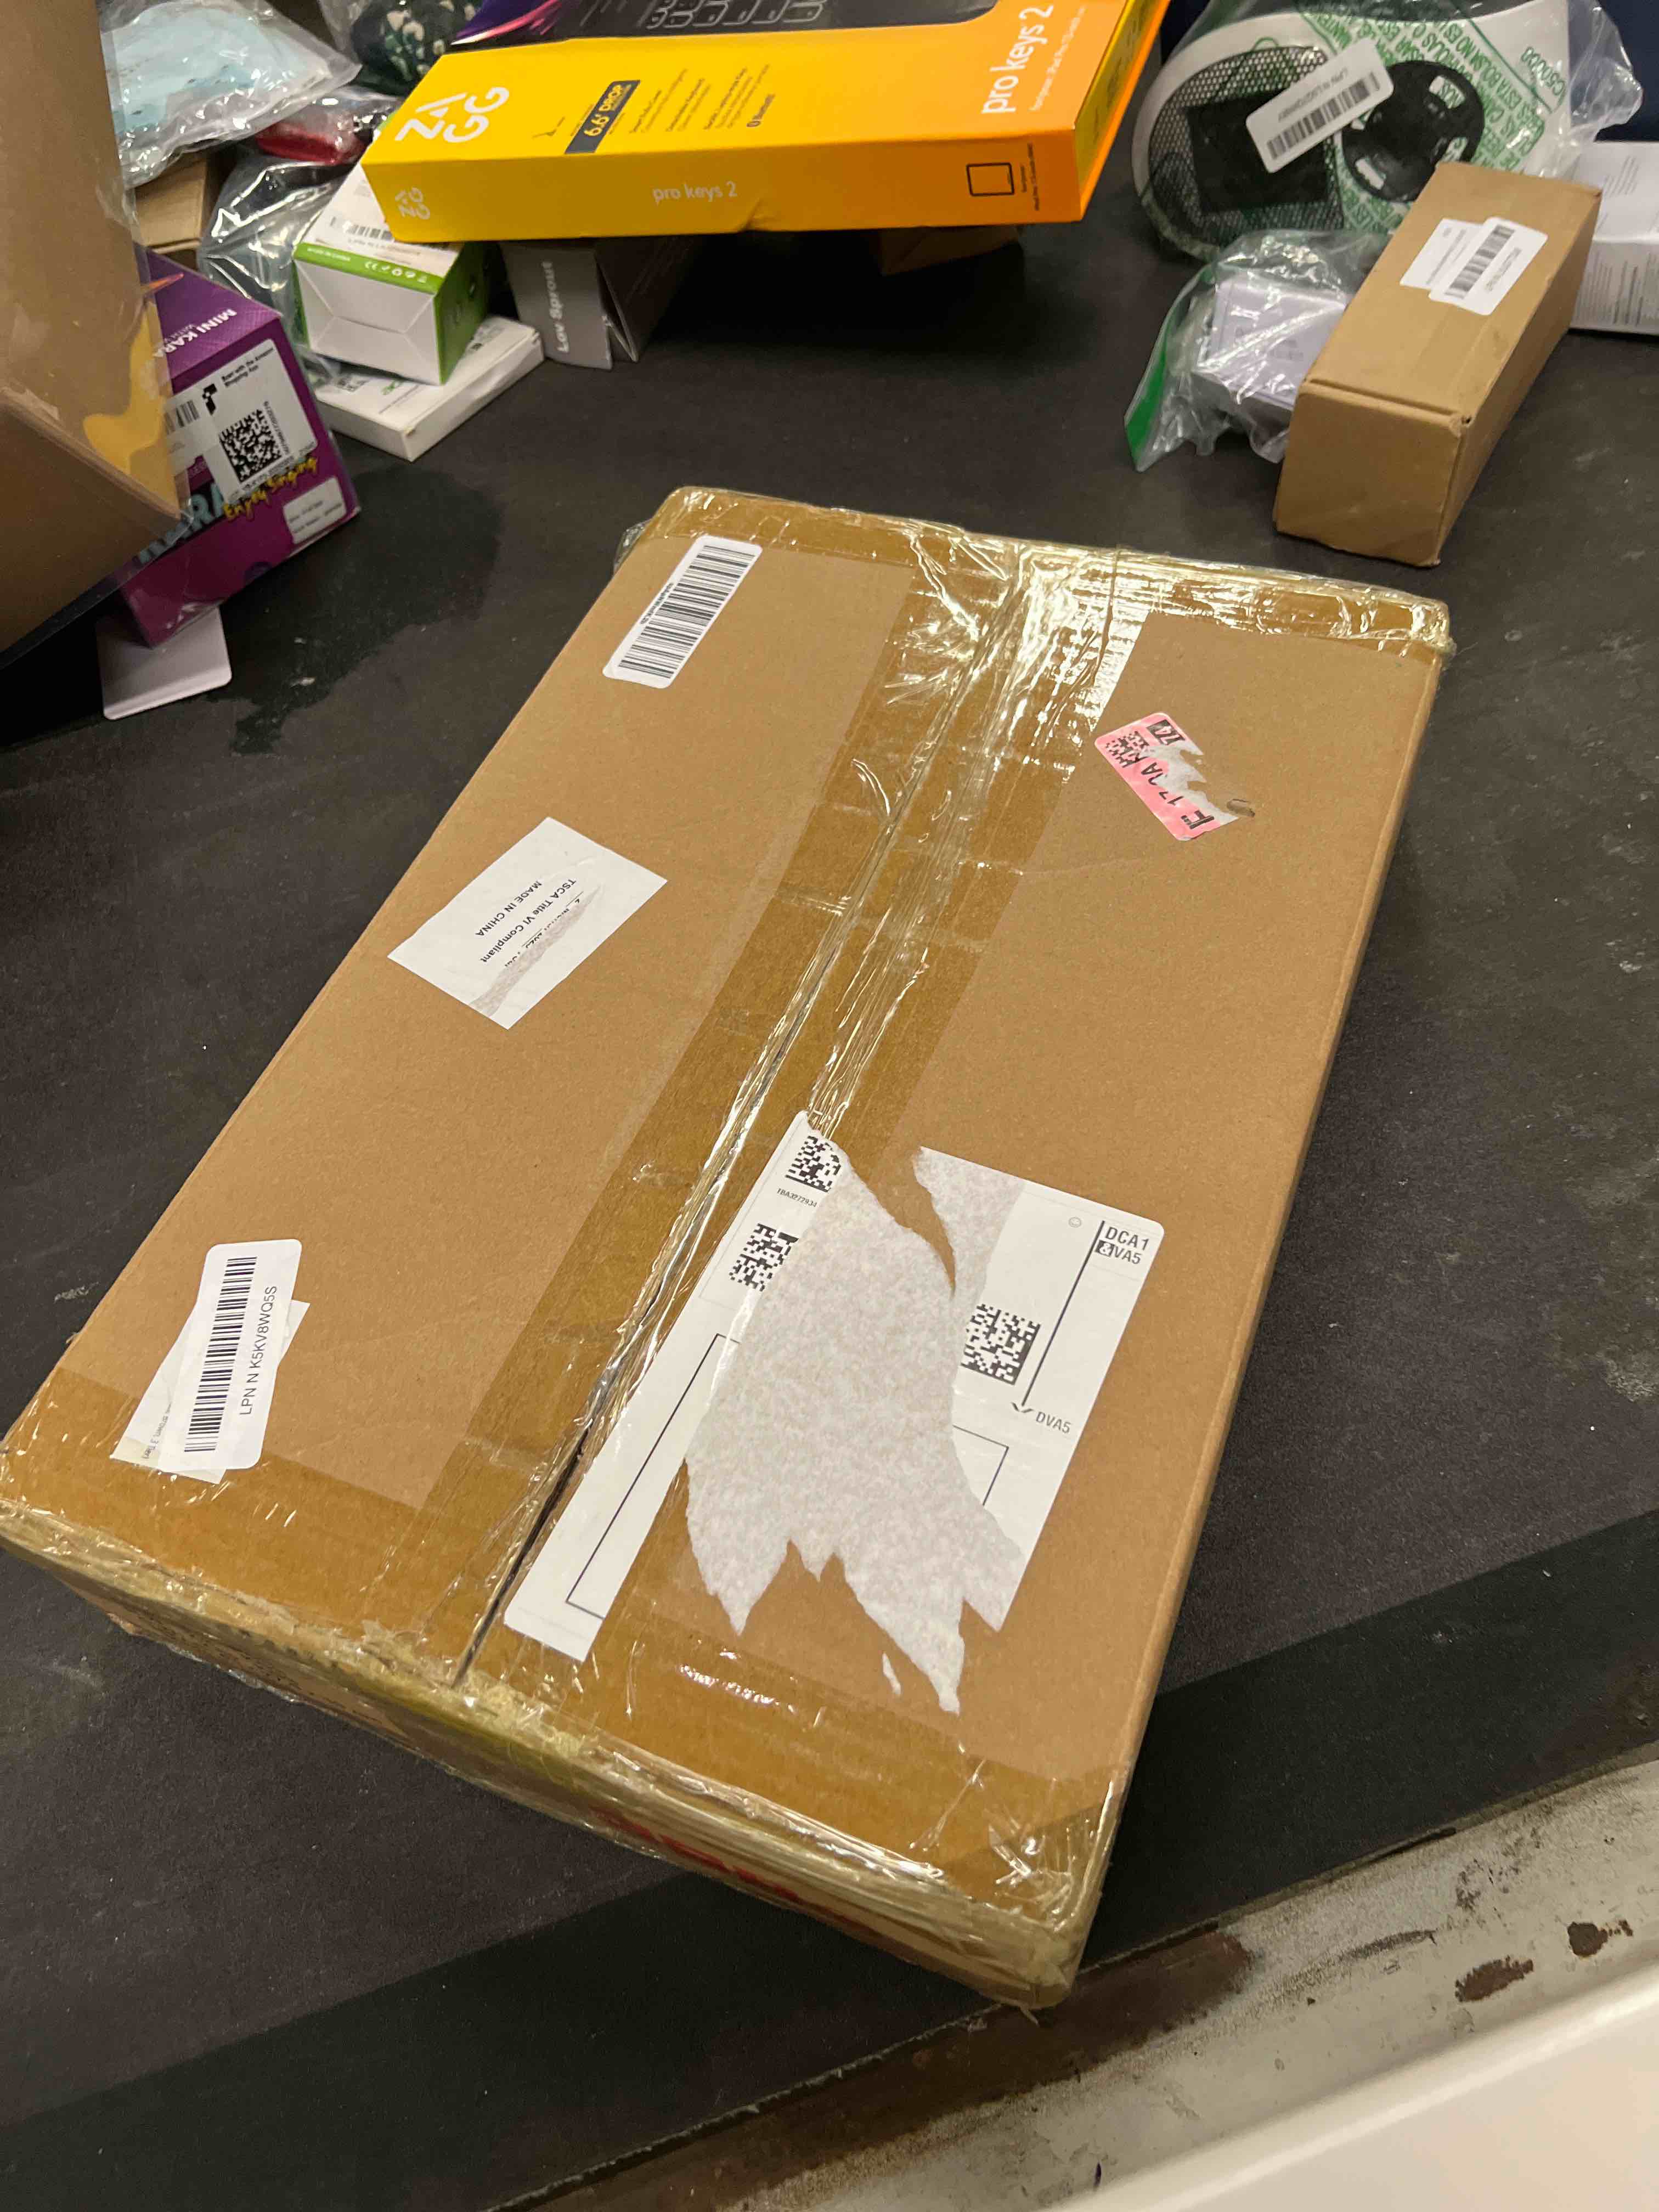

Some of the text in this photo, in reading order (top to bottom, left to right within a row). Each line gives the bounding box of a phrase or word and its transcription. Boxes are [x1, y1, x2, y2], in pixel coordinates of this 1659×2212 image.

[1019, 4, 1054, 20] 2
[990, 24, 1048, 72] keys
[981, 75, 1019, 114] pro
[653, 180, 738, 207] pro keys 2
[196, 308, 238, 334] MINI
[549, 879, 577, 899] TSCA
[475, 881, 543, 937] MADE IN CHINA
[523, 916, 536, 926] VI
[532, 900, 554, 916] Title
[481, 925, 524, 963] Compliant
[1105, 1226, 1149, 1251] DCA1
[240, 1285, 278, 1415] LPN N K5KV8WQ5S
[1035, 1410, 1071, 1434] DVA5
